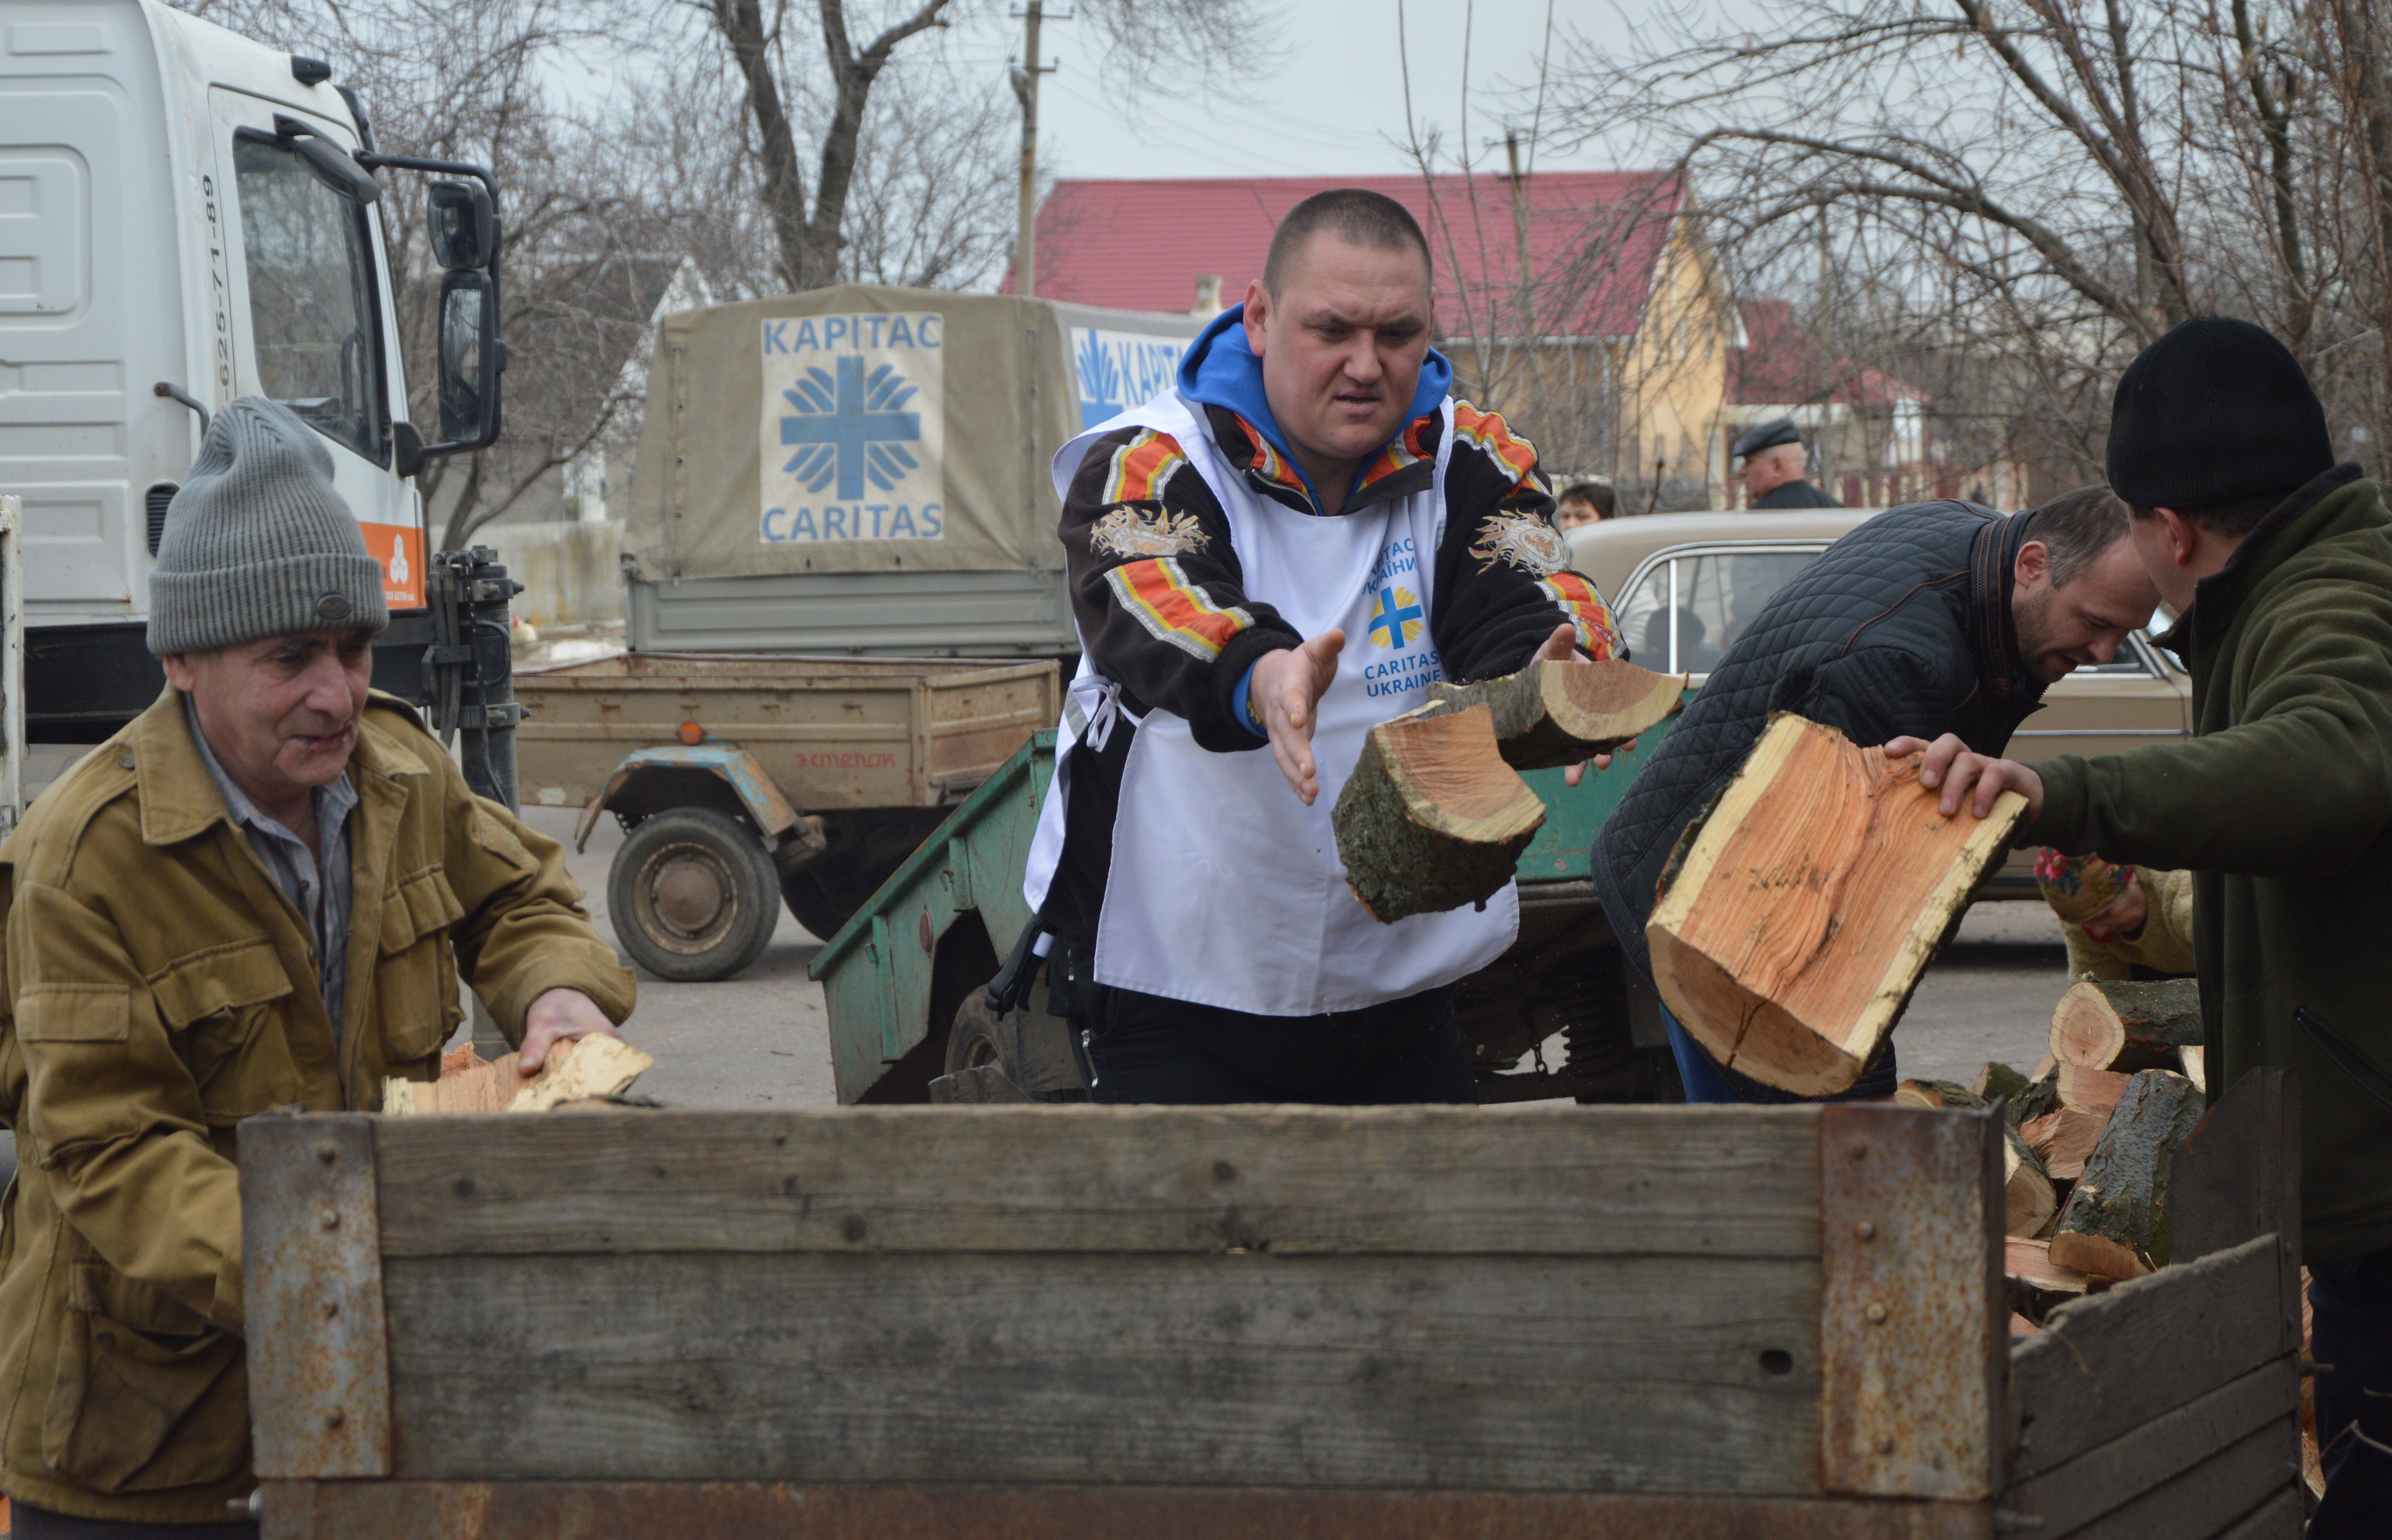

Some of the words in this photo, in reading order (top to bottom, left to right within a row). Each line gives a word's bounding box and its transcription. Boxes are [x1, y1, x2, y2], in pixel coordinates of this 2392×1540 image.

[764, 315, 940, 353] КАРІТАС
[1118, 340, 1184, 405] КАРІТ
[762, 503, 943, 541] CARITAS
[1365, 650, 1439, 680] CARITAS
[1367, 669, 1441, 697] UKRAINE
